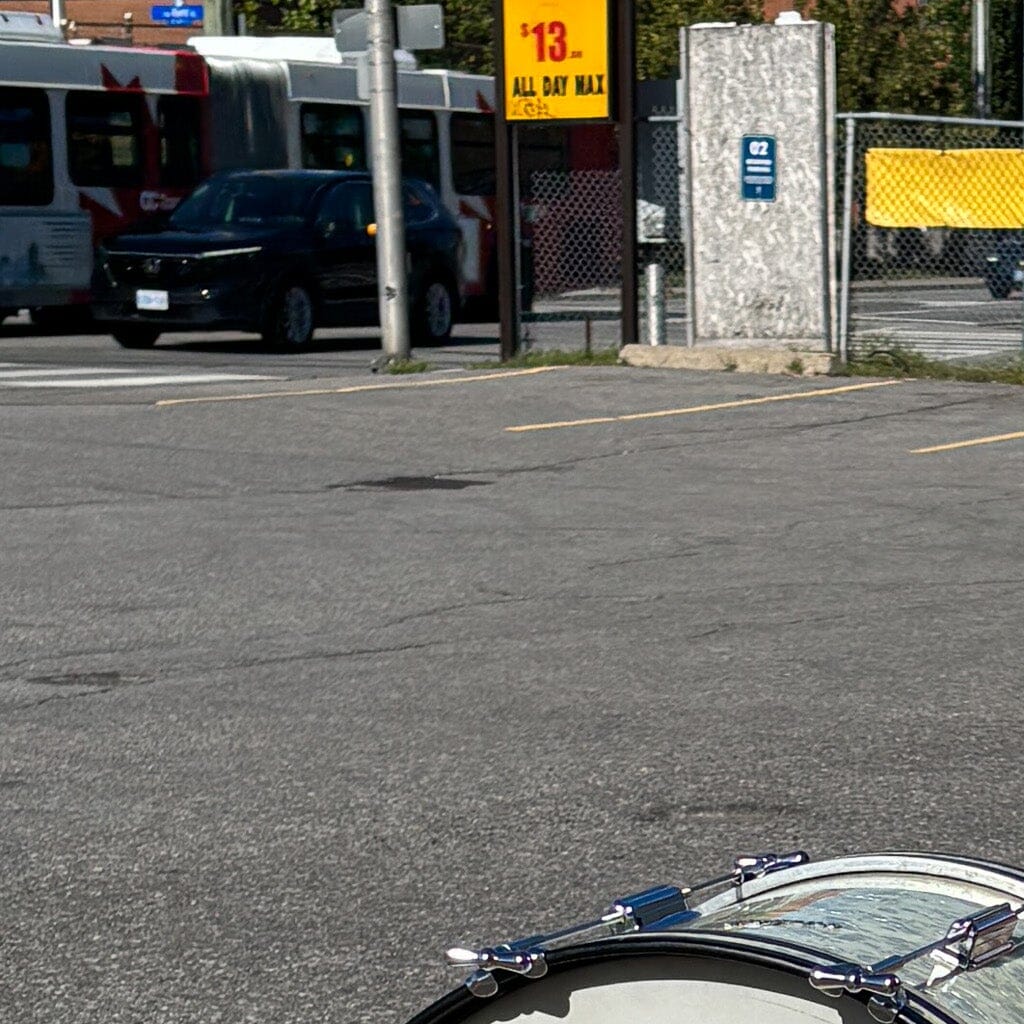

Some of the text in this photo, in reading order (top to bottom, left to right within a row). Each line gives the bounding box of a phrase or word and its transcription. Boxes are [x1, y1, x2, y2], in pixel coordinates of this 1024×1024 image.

[512, 74, 605, 97] ALL DAY MAX
[749, 141, 769, 155] 02
